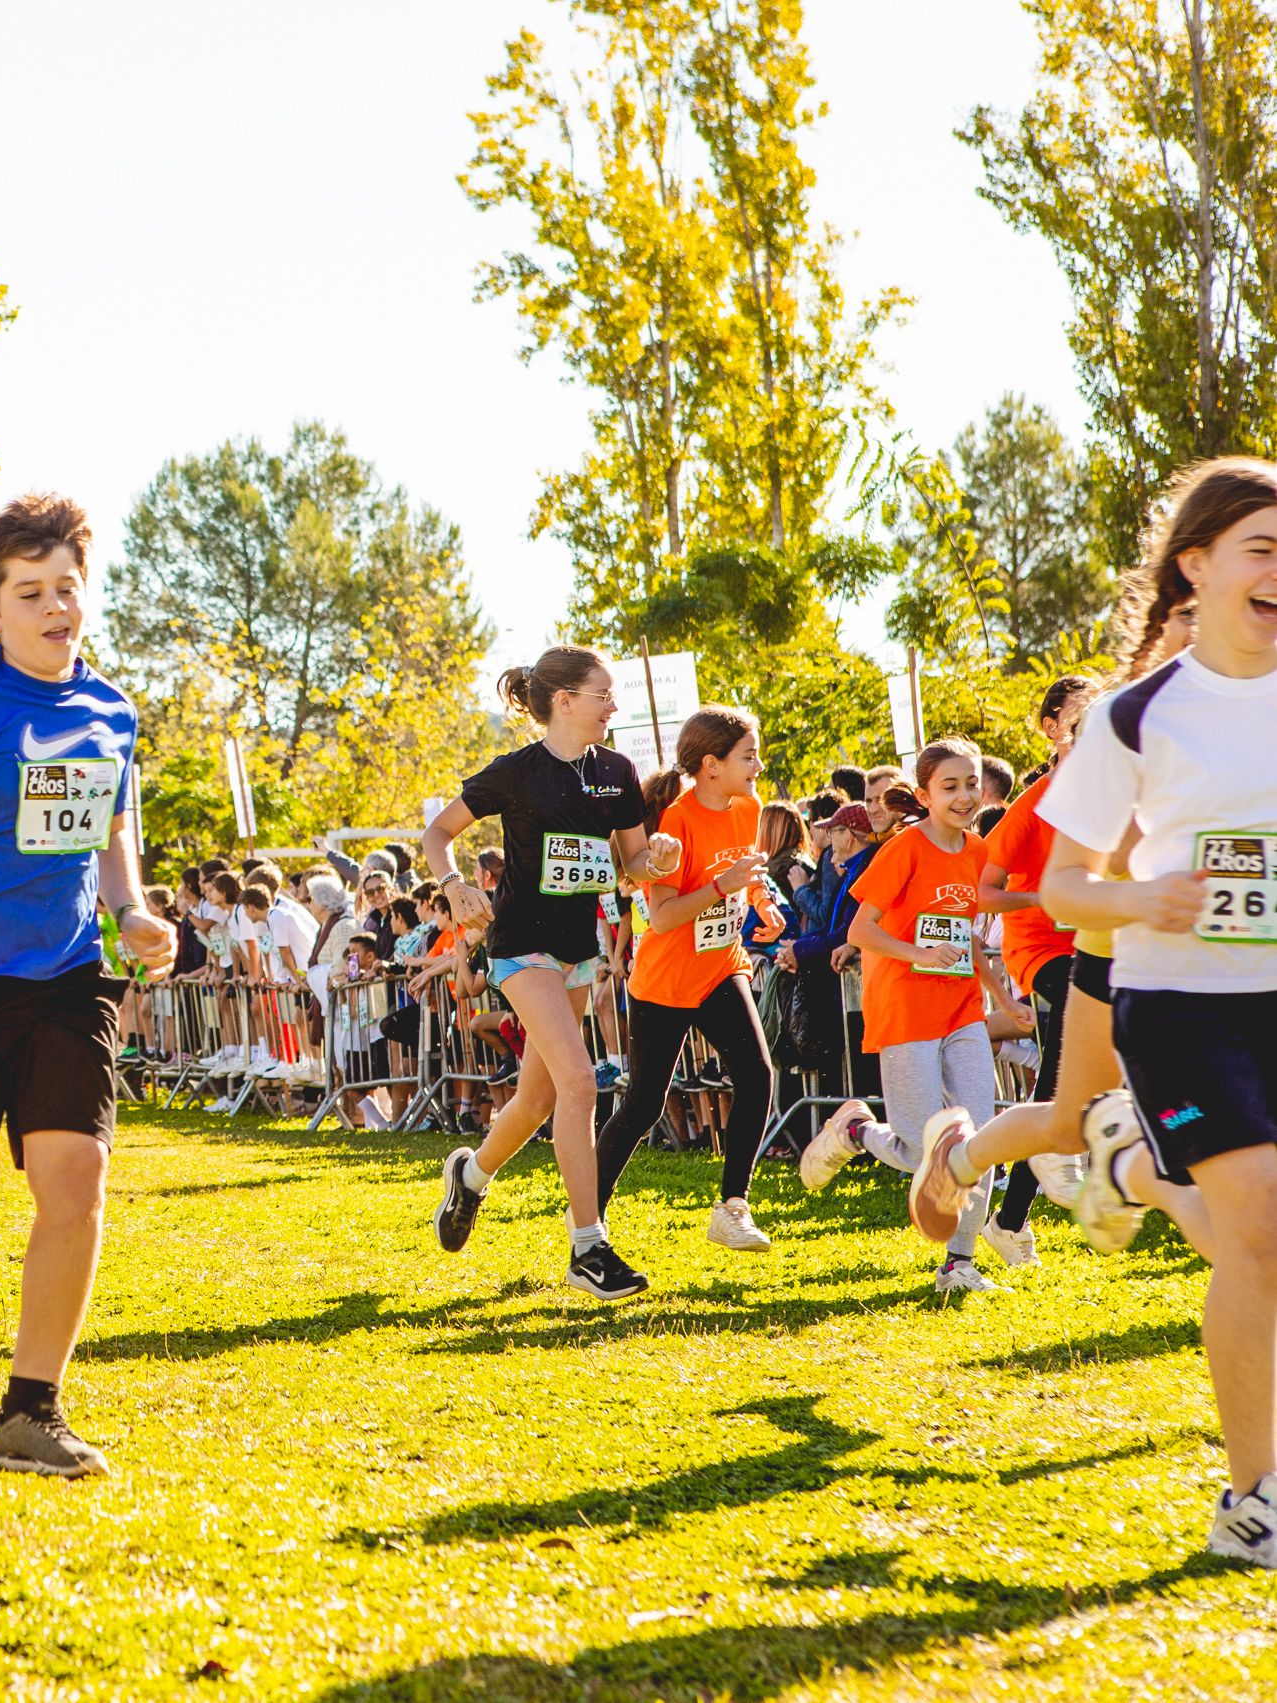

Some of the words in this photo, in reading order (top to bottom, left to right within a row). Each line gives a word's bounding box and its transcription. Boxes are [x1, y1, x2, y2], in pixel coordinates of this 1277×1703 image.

[27, 779, 66, 794] CROS
[43, 810, 92, 832] 104
[550, 846, 579, 857] CROS
[1206, 854, 1264, 872] CROS
[552, 866, 608, 884] 3698
[1212, 890, 1277, 917] 26
[700, 906, 725, 918] CROS
[922, 926, 950, 937] CROS
